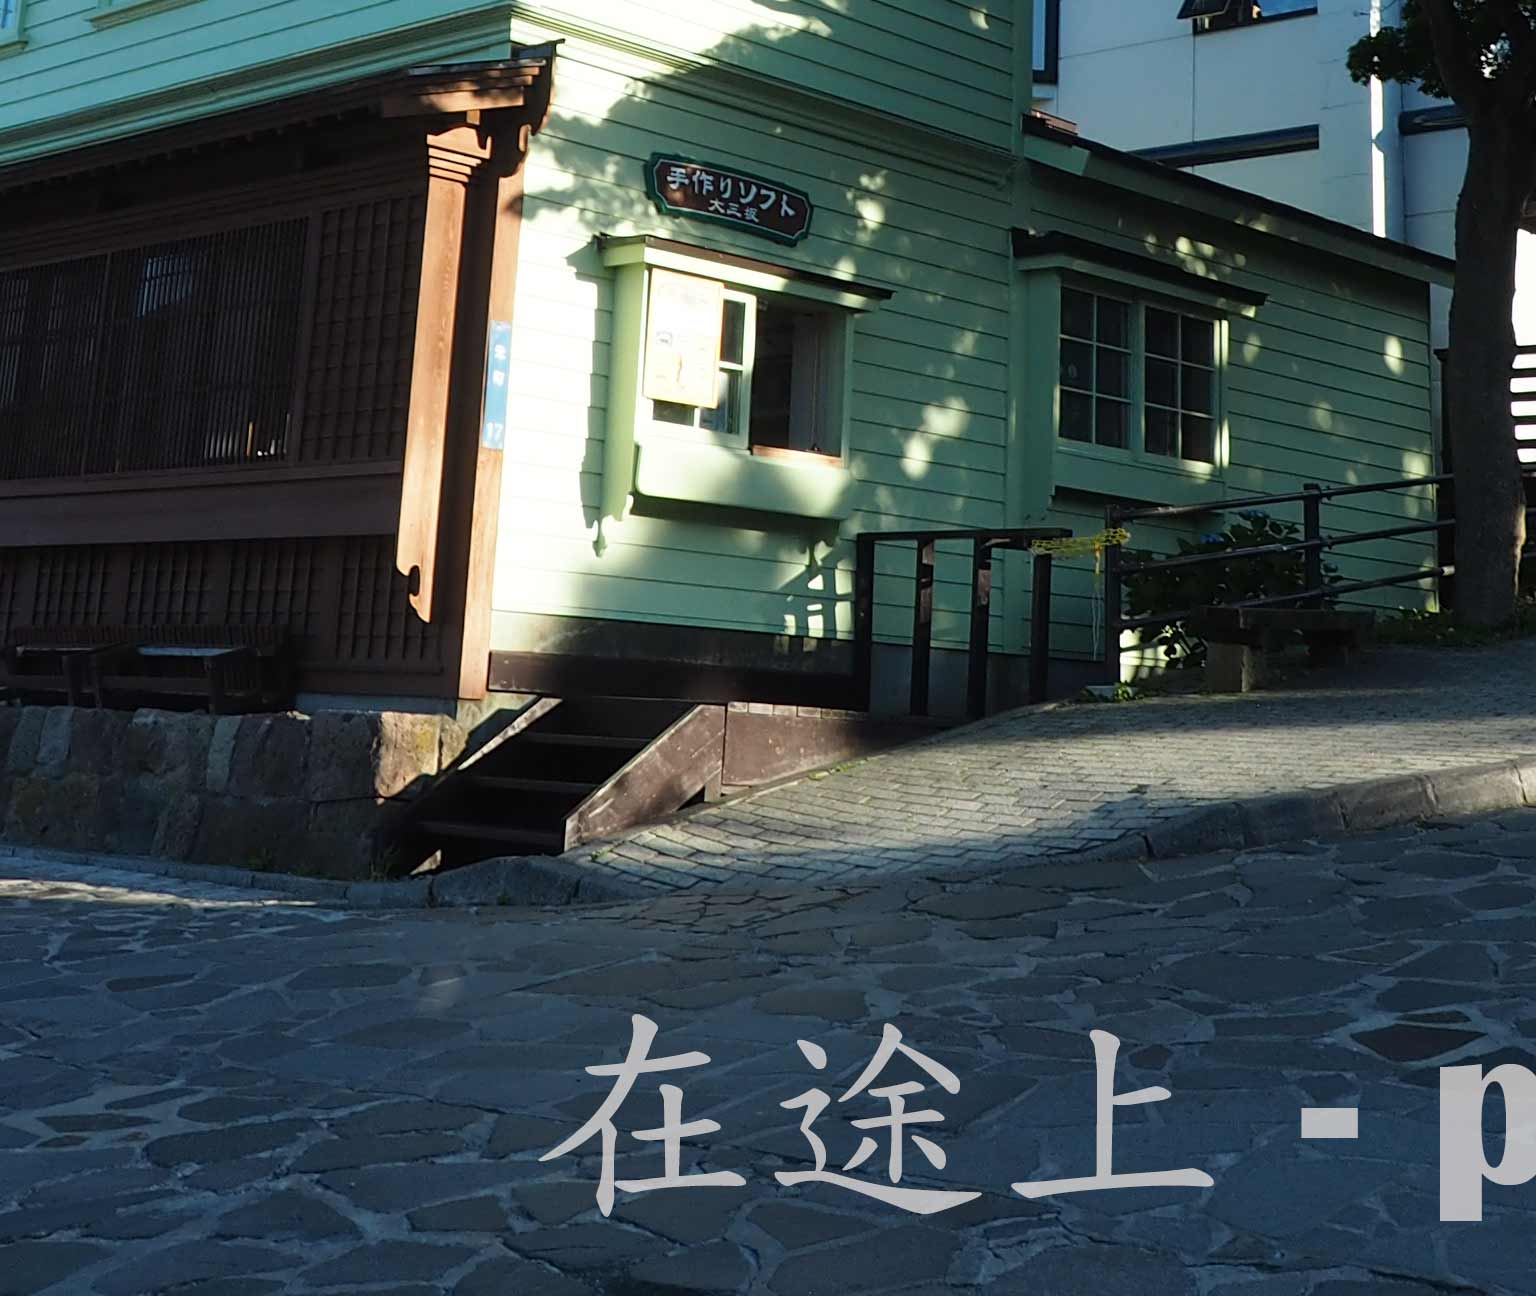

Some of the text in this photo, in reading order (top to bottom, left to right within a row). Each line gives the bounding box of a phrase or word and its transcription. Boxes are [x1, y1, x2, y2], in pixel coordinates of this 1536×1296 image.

[666, 166, 796, 217] 手作りソフト
[708, 198, 759, 223] 大三坂
